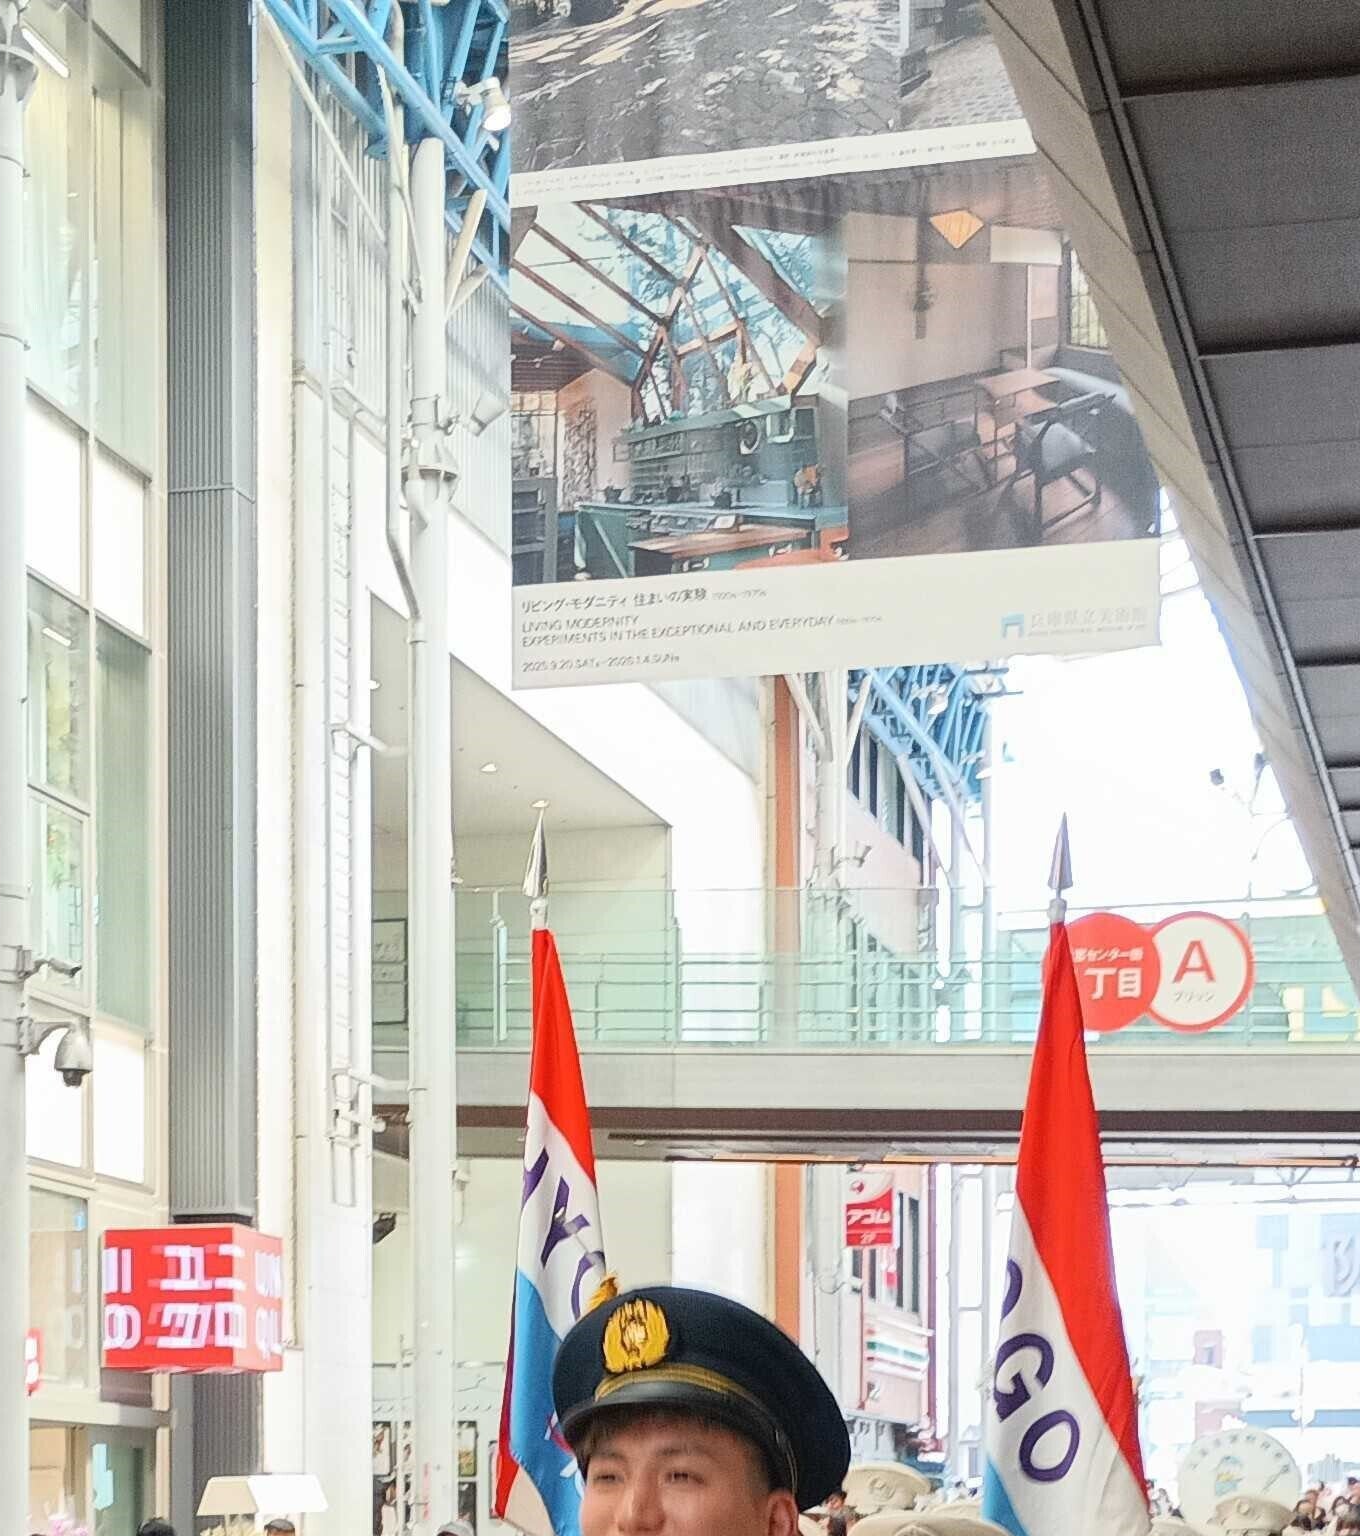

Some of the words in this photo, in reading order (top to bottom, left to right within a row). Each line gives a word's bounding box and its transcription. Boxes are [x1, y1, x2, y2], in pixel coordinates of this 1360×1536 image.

[609, 630, 624, 643] IN
[626, 628, 650, 641] THE
[738, 619, 766, 634] AND
[769, 615, 835, 632] EVERYDAY
[1172, 940, 1216, 984] A
[847, 1208, 891, 1226] アコム
